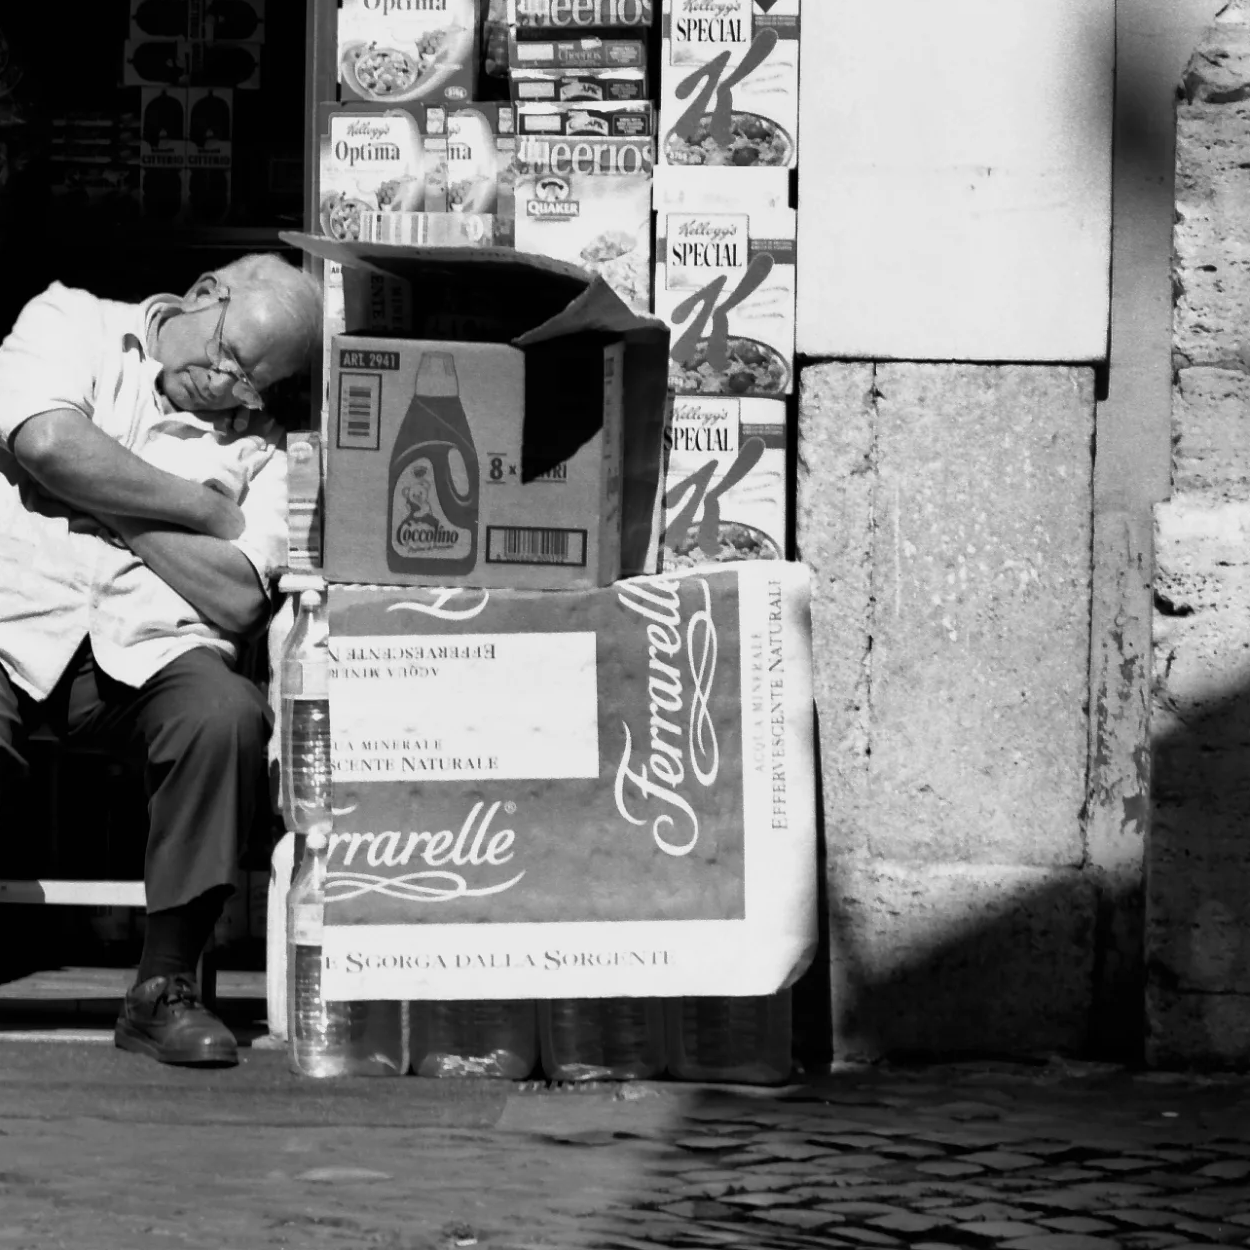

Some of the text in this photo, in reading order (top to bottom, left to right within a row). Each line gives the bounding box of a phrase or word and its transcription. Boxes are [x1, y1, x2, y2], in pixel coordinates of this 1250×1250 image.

[676, 18, 747, 43] SPECIAL
[335, 140, 401, 167] Optima
[528, 201, 579, 214] QUAKER
[678, 219, 737, 241] Kellogg's
[672, 243, 743, 267] SPECIAL
[369, 353, 397, 368] 2941
[664, 427, 734, 452] SPECIAL
[490, 457, 503, 480] 8
[397, 520, 459, 547] Coccolino
[346, 643, 496, 660] EFFERVESCENTE
[329, 664, 440, 679] ACQUA MINER
[401, 756, 499, 772] NATURALE
[769, 676, 788, 831] EFFERVESCENTE
[326, 801, 517, 867] rrarelle
[346, 951, 448, 974] SGORGA
[455, 953, 536, 969] DALLA
